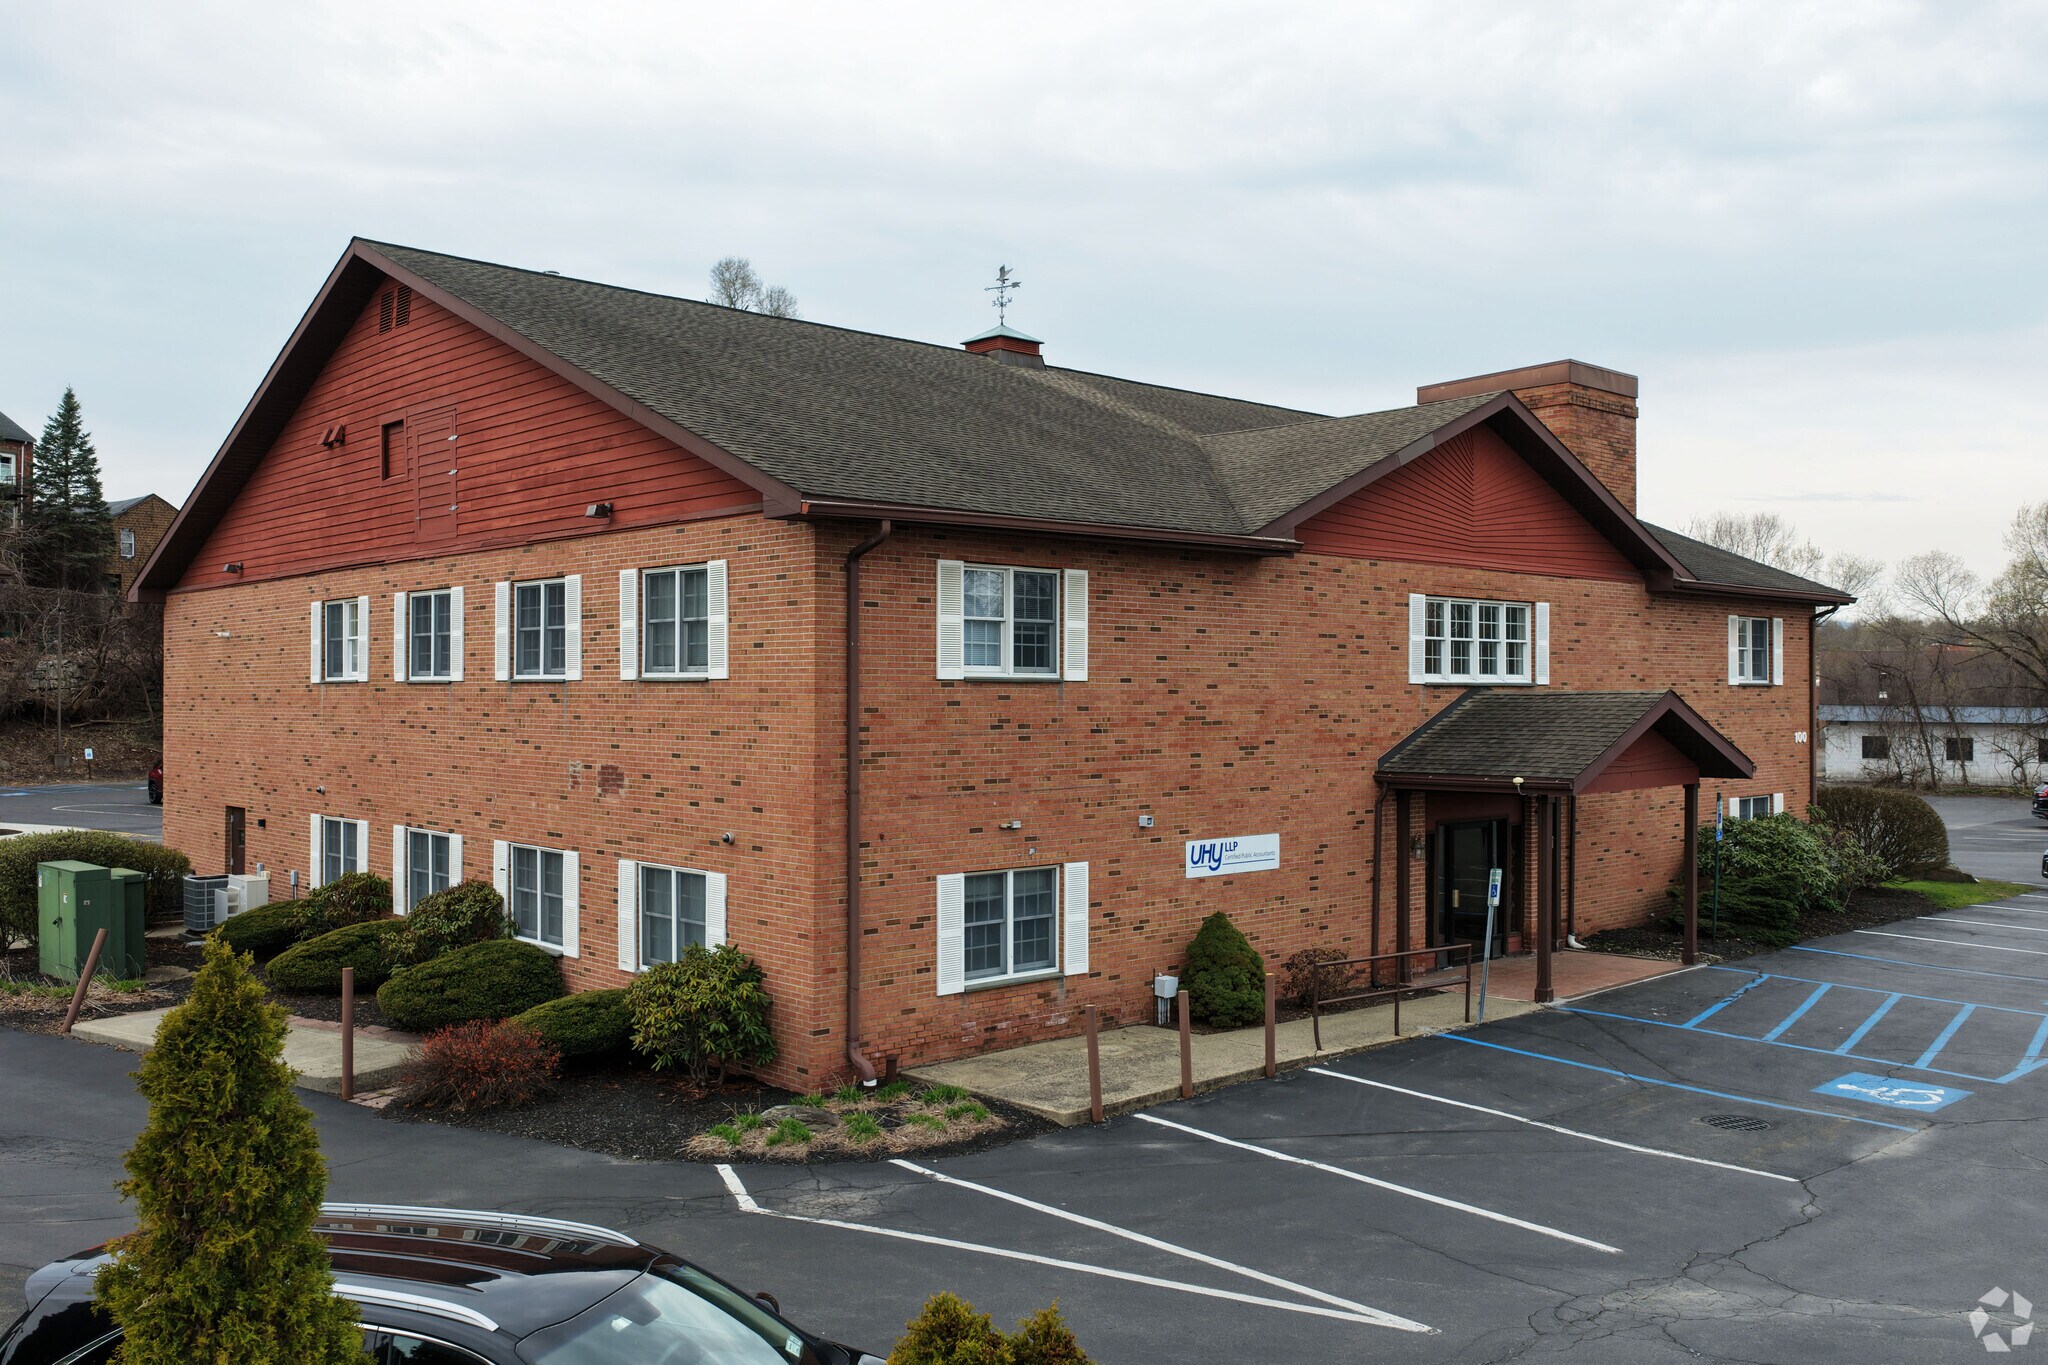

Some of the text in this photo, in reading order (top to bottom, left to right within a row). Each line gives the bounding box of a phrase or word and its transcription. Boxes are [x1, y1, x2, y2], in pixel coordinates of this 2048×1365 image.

[1794, 731, 1807, 744] 100
[1225, 841, 1238, 852] LLP
[1225, 853, 1241, 861] Certified
[1253, 850, 1276, 858] Accountants
